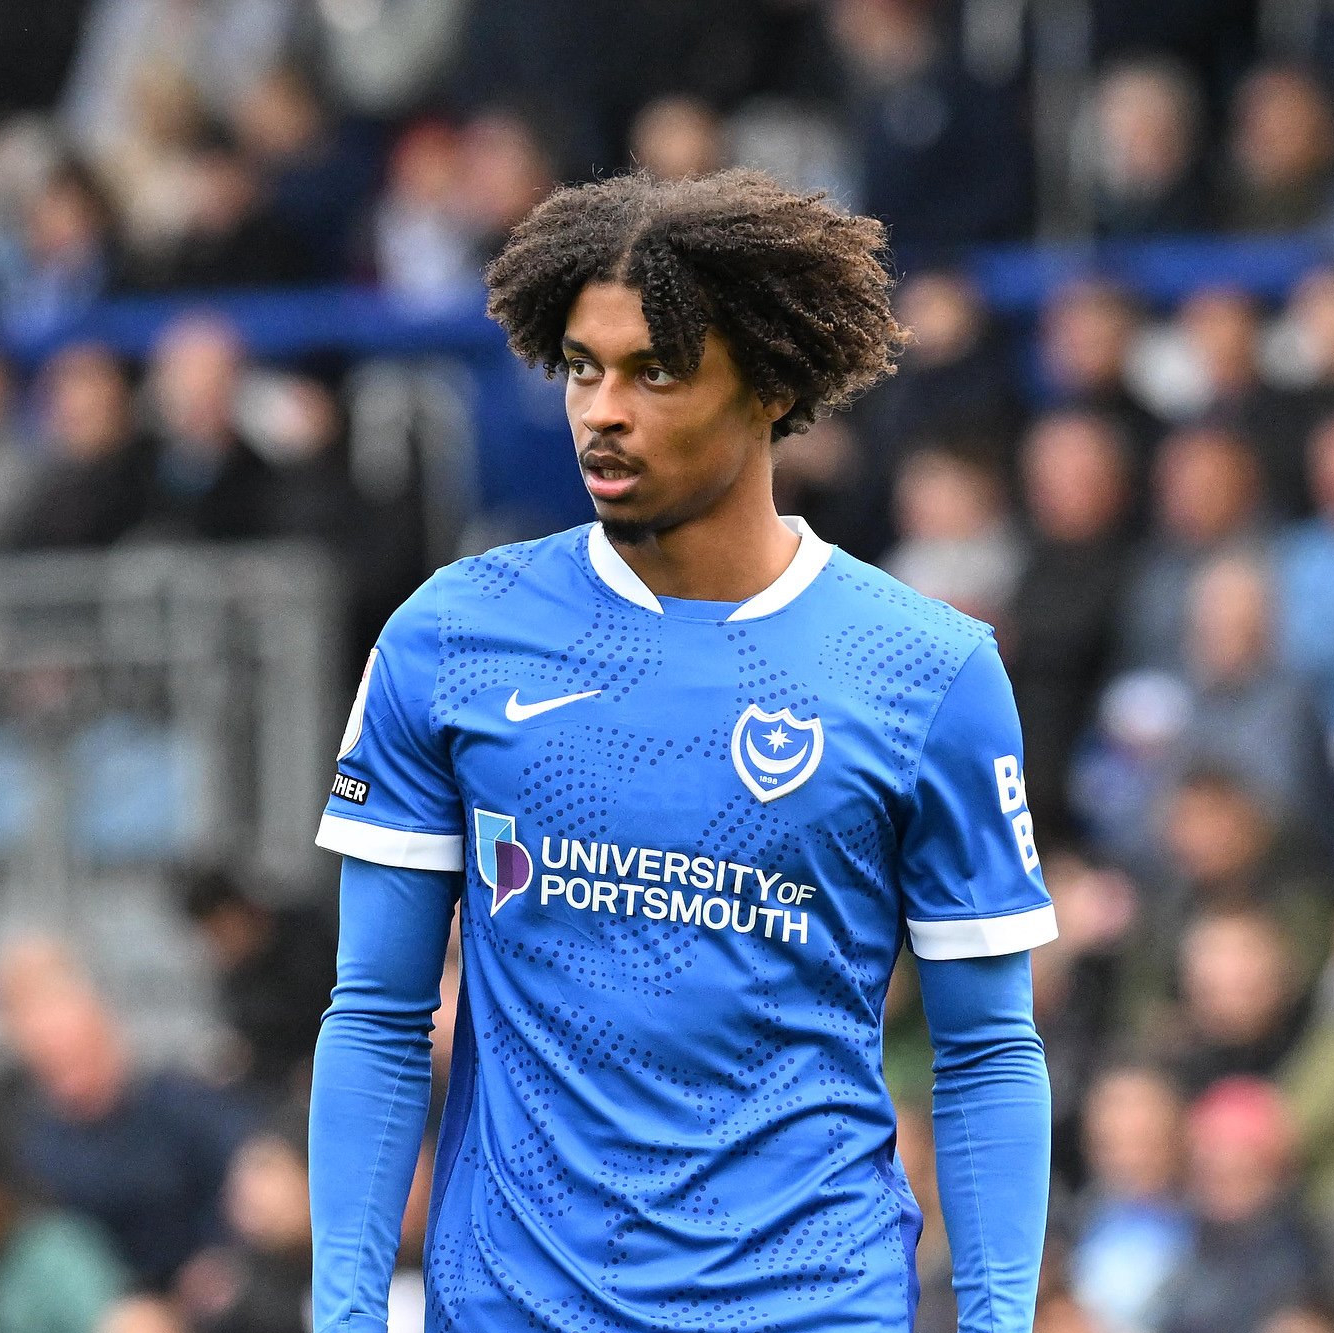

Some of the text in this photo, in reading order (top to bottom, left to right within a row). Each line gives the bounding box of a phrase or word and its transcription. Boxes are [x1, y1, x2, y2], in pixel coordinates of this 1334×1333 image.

[759, 775, 778, 785] 1898
[541, 836, 817, 905] UNIVERSITY OF
[540, 874, 809, 944] PORTSMOUTH
